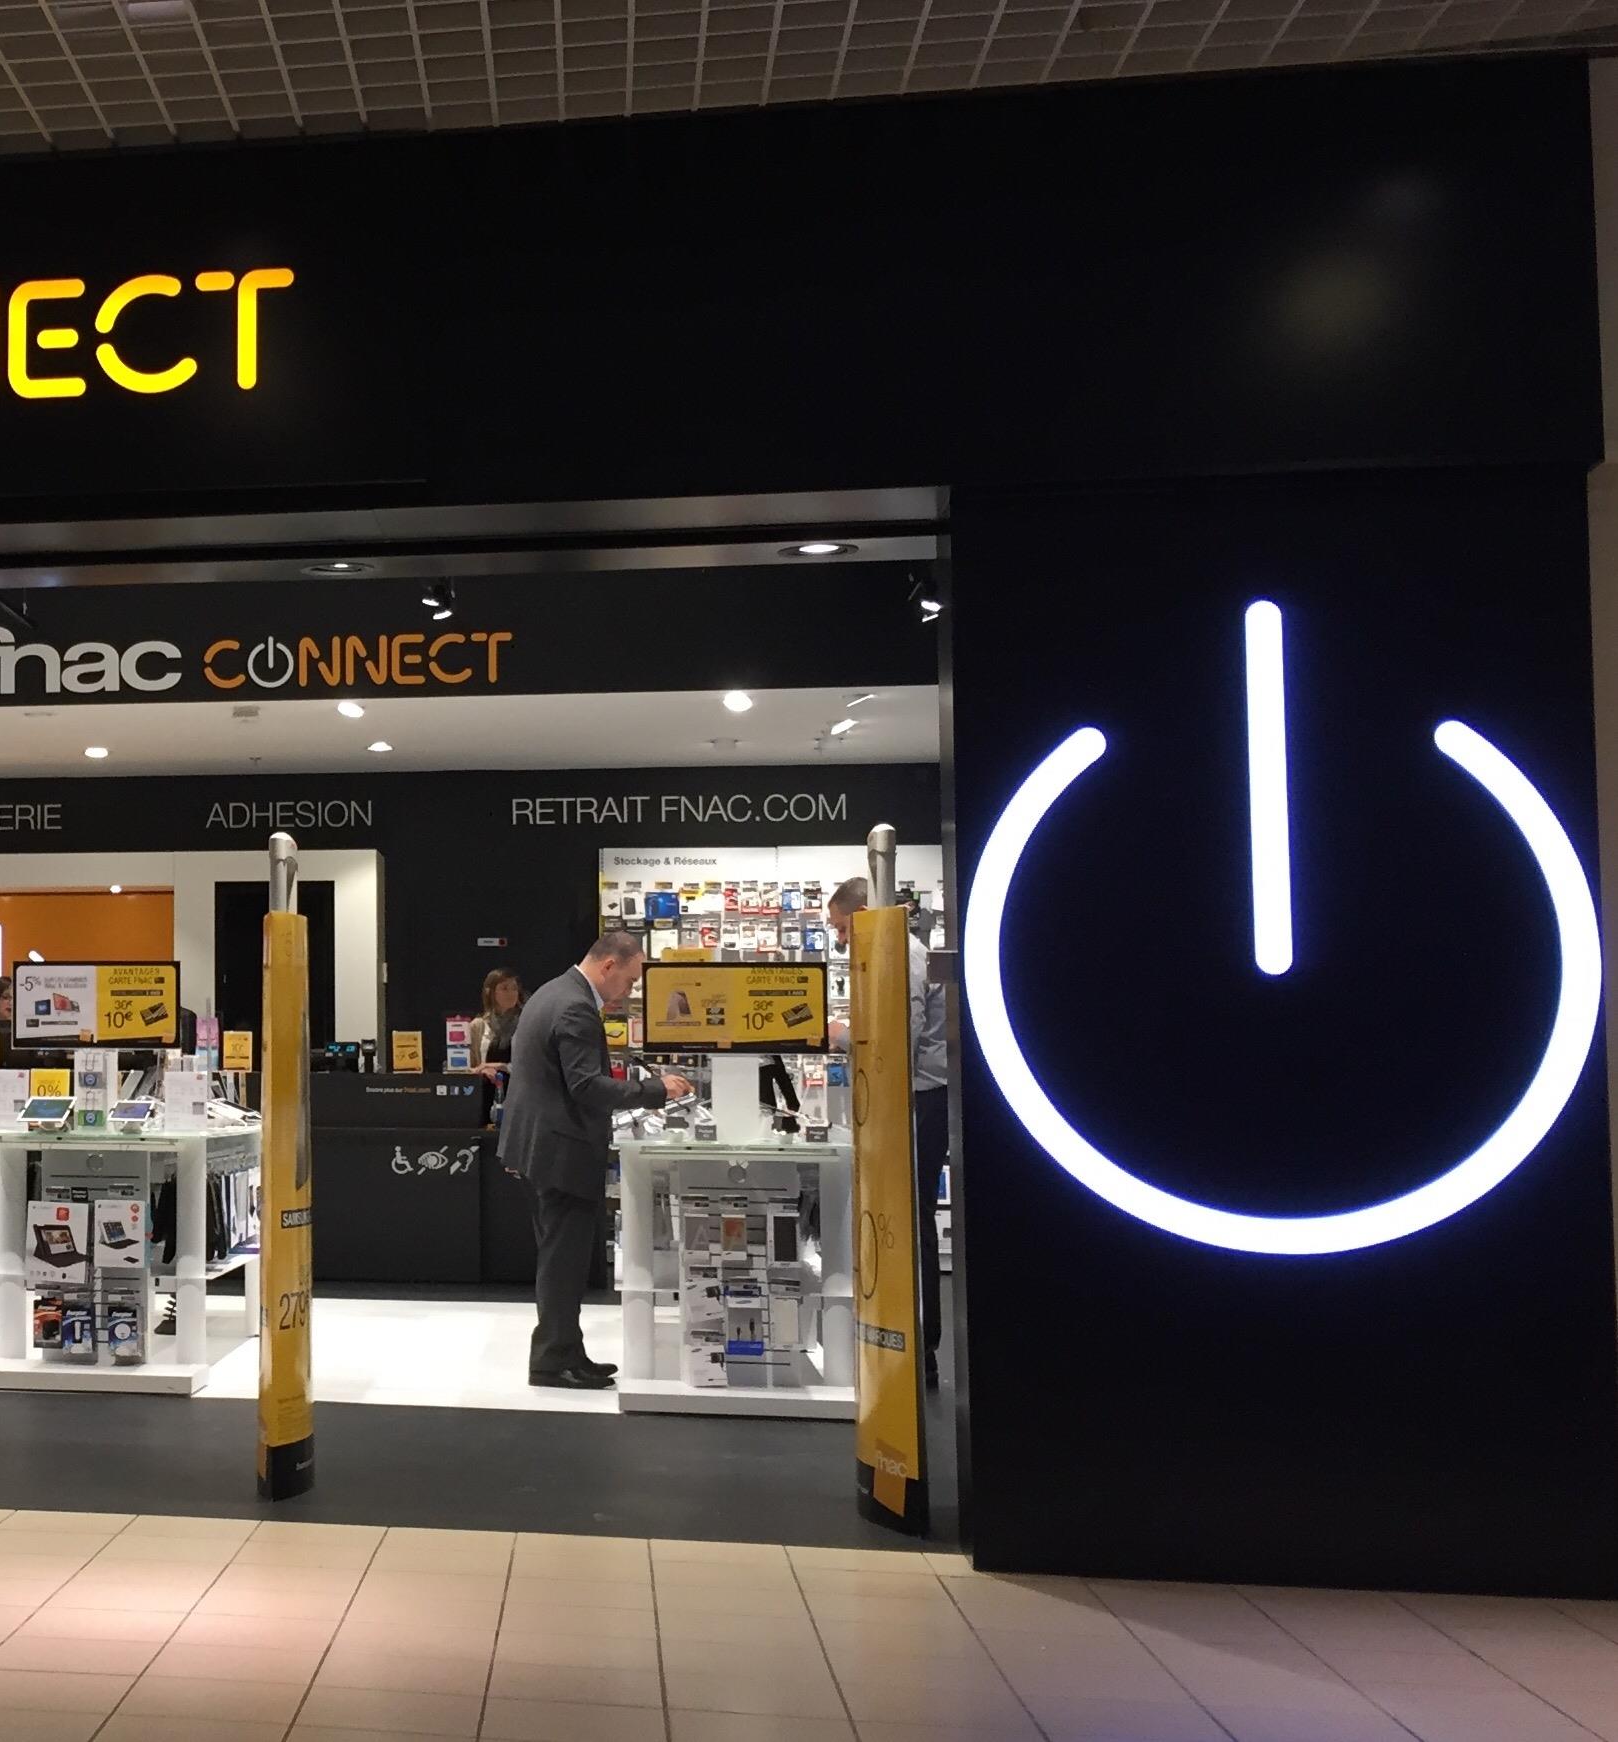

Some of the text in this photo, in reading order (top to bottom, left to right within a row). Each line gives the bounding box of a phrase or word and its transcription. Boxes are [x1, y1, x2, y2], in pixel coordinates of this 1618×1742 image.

[204, 632, 513, 688] CONNECT
[206, 801, 373, 831] ADHESION
[511, 793, 848, 825] RETRAIT FNAC.COM
[613, 856, 717, 868] Stockage & Réseaux
[103, 1010, 134, 1029] 10€
[741, 1012, 775, 1031] 10€
[877, 1450, 908, 1479] fnac
